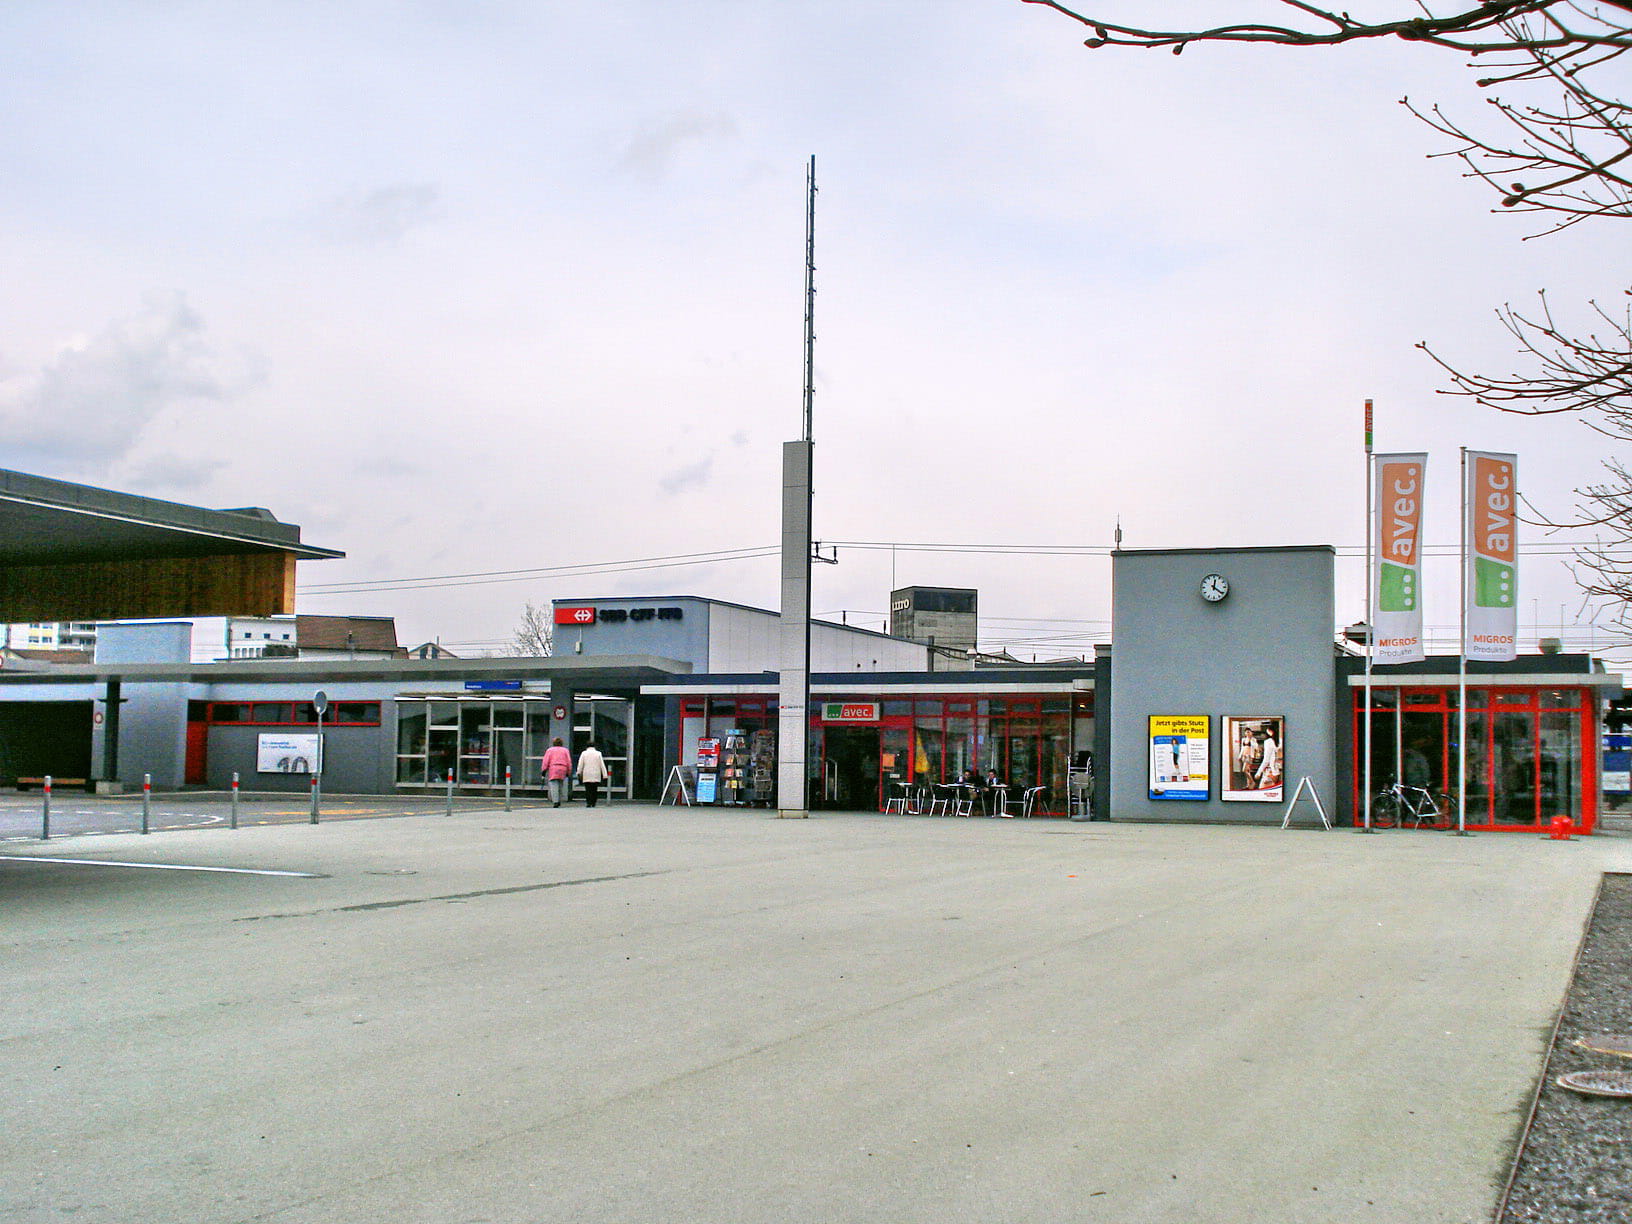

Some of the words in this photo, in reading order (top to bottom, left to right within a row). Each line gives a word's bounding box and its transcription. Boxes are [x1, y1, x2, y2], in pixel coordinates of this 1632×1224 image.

[1392, 467, 1417, 557] avec.
[1486, 465, 1511, 552] avec.
[1379, 637, 1418, 647] MIGROS
[1473, 634, 1514, 644] MIGROS
[1379, 649, 1412, 658] Produkte
[1473, 645, 1507, 654] Produkte
